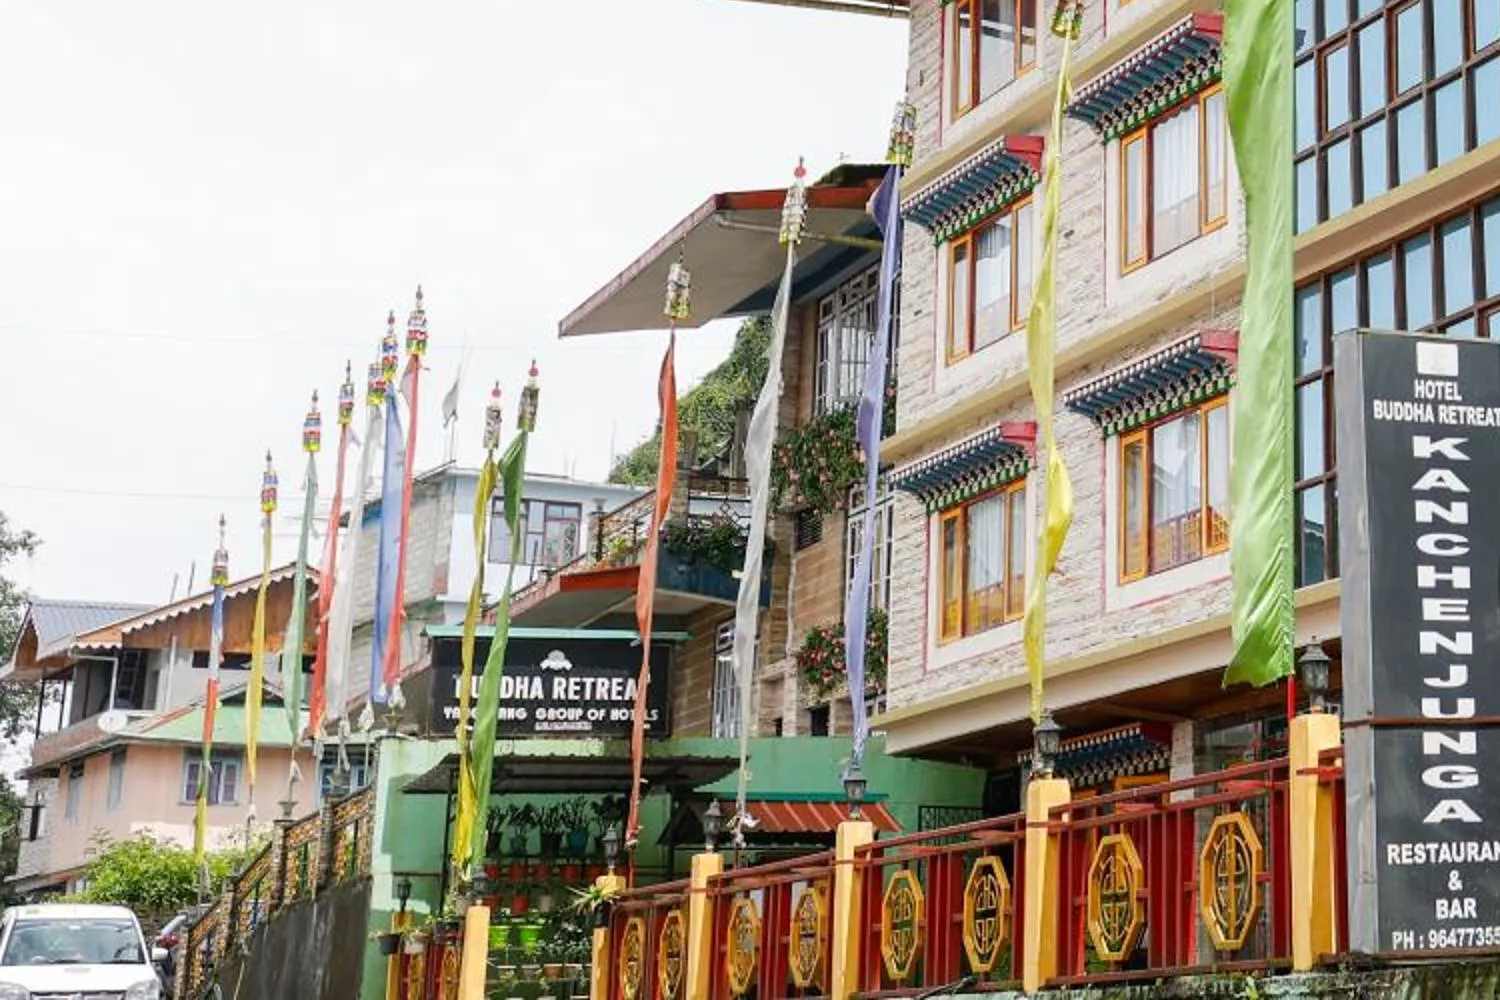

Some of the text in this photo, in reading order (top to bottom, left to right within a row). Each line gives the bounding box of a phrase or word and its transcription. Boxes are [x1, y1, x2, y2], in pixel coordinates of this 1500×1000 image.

[1414, 379, 1462, 401] HOTEL
[1373, 399, 1435, 424] BUDDHA
[1412, 435, 1483, 824] KANCHENJUNGA
[455, 675, 648, 701] UDHA RETREA
[535, 707, 584, 721] GROUP
[587, 708, 606, 721] OF
[610, 708, 659, 721] HOTLS
[1448, 869, 1463, 891] &
[1435, 897, 1478, 920] BAR
[1391, 930, 1415, 950] PH
